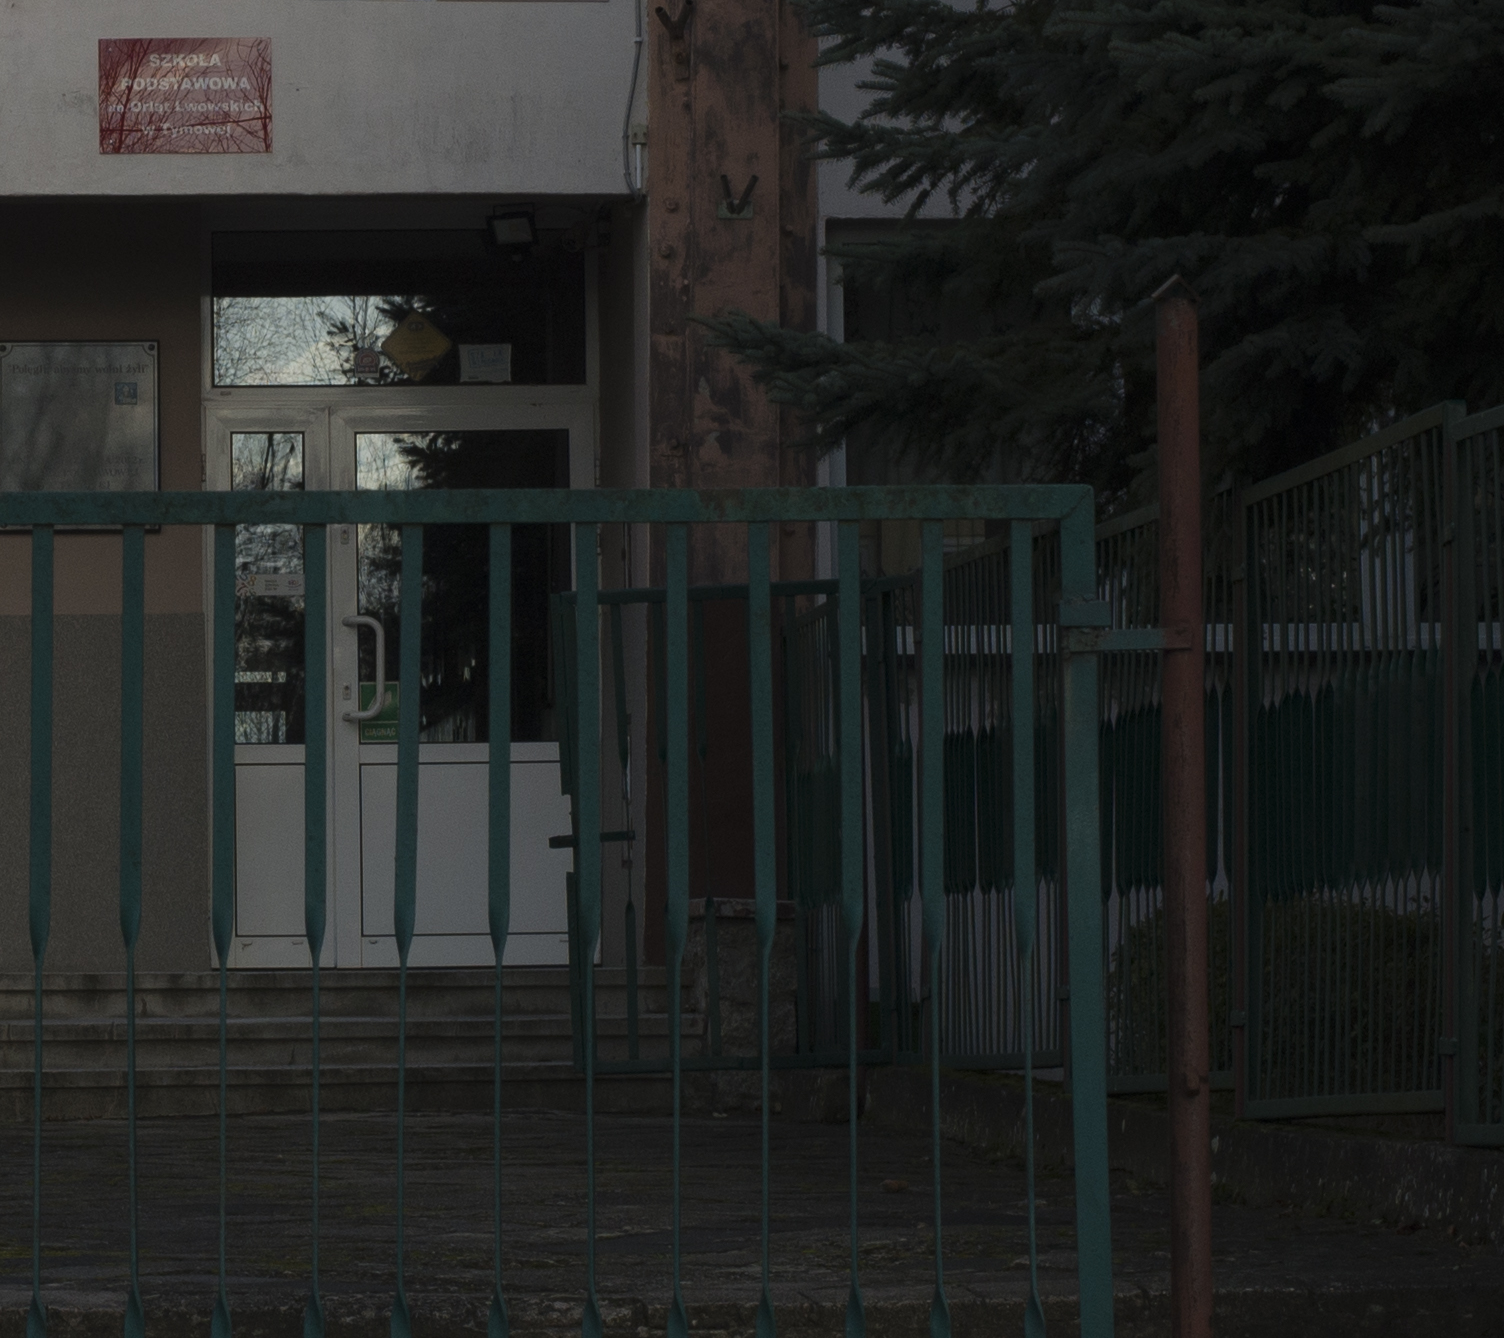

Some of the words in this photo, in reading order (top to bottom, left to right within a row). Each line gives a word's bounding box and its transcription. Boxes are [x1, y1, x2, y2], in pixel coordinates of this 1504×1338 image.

[149, 53, 221, 67] SZKOŁA
[121, 77, 251, 91] PODSTAWOWA
[175, 100, 265, 113] Lwowskich
[160, 122, 232, 137] Tymowej
